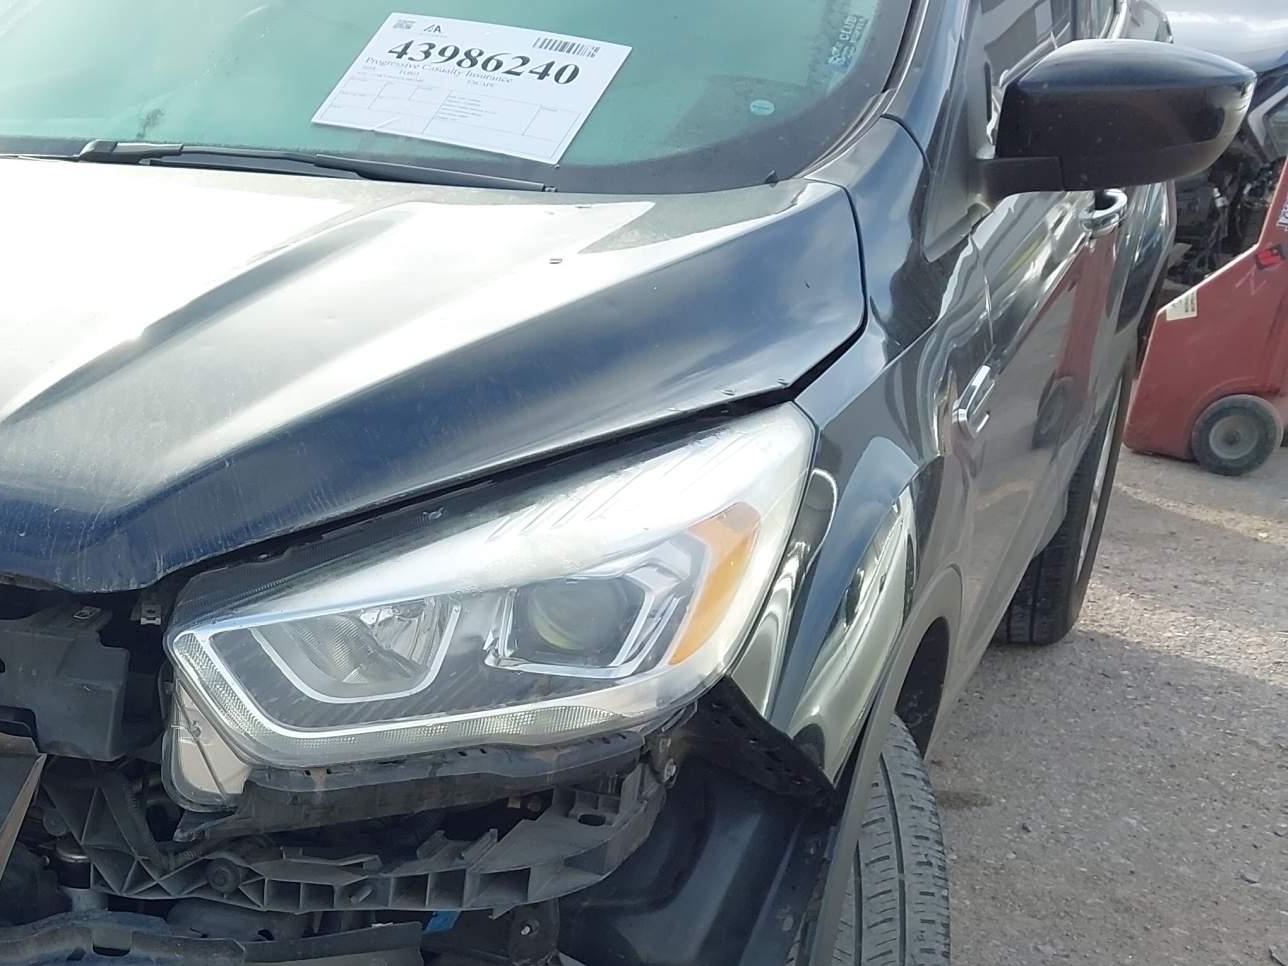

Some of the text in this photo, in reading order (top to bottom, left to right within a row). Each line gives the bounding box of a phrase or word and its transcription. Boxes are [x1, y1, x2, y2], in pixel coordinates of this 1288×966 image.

[365, 57, 420, 71] Progressive
[422, 63, 464, 78] Casualty
[465, 70, 513, 84] Insurance
[388, 40, 580, 85] 43986240
